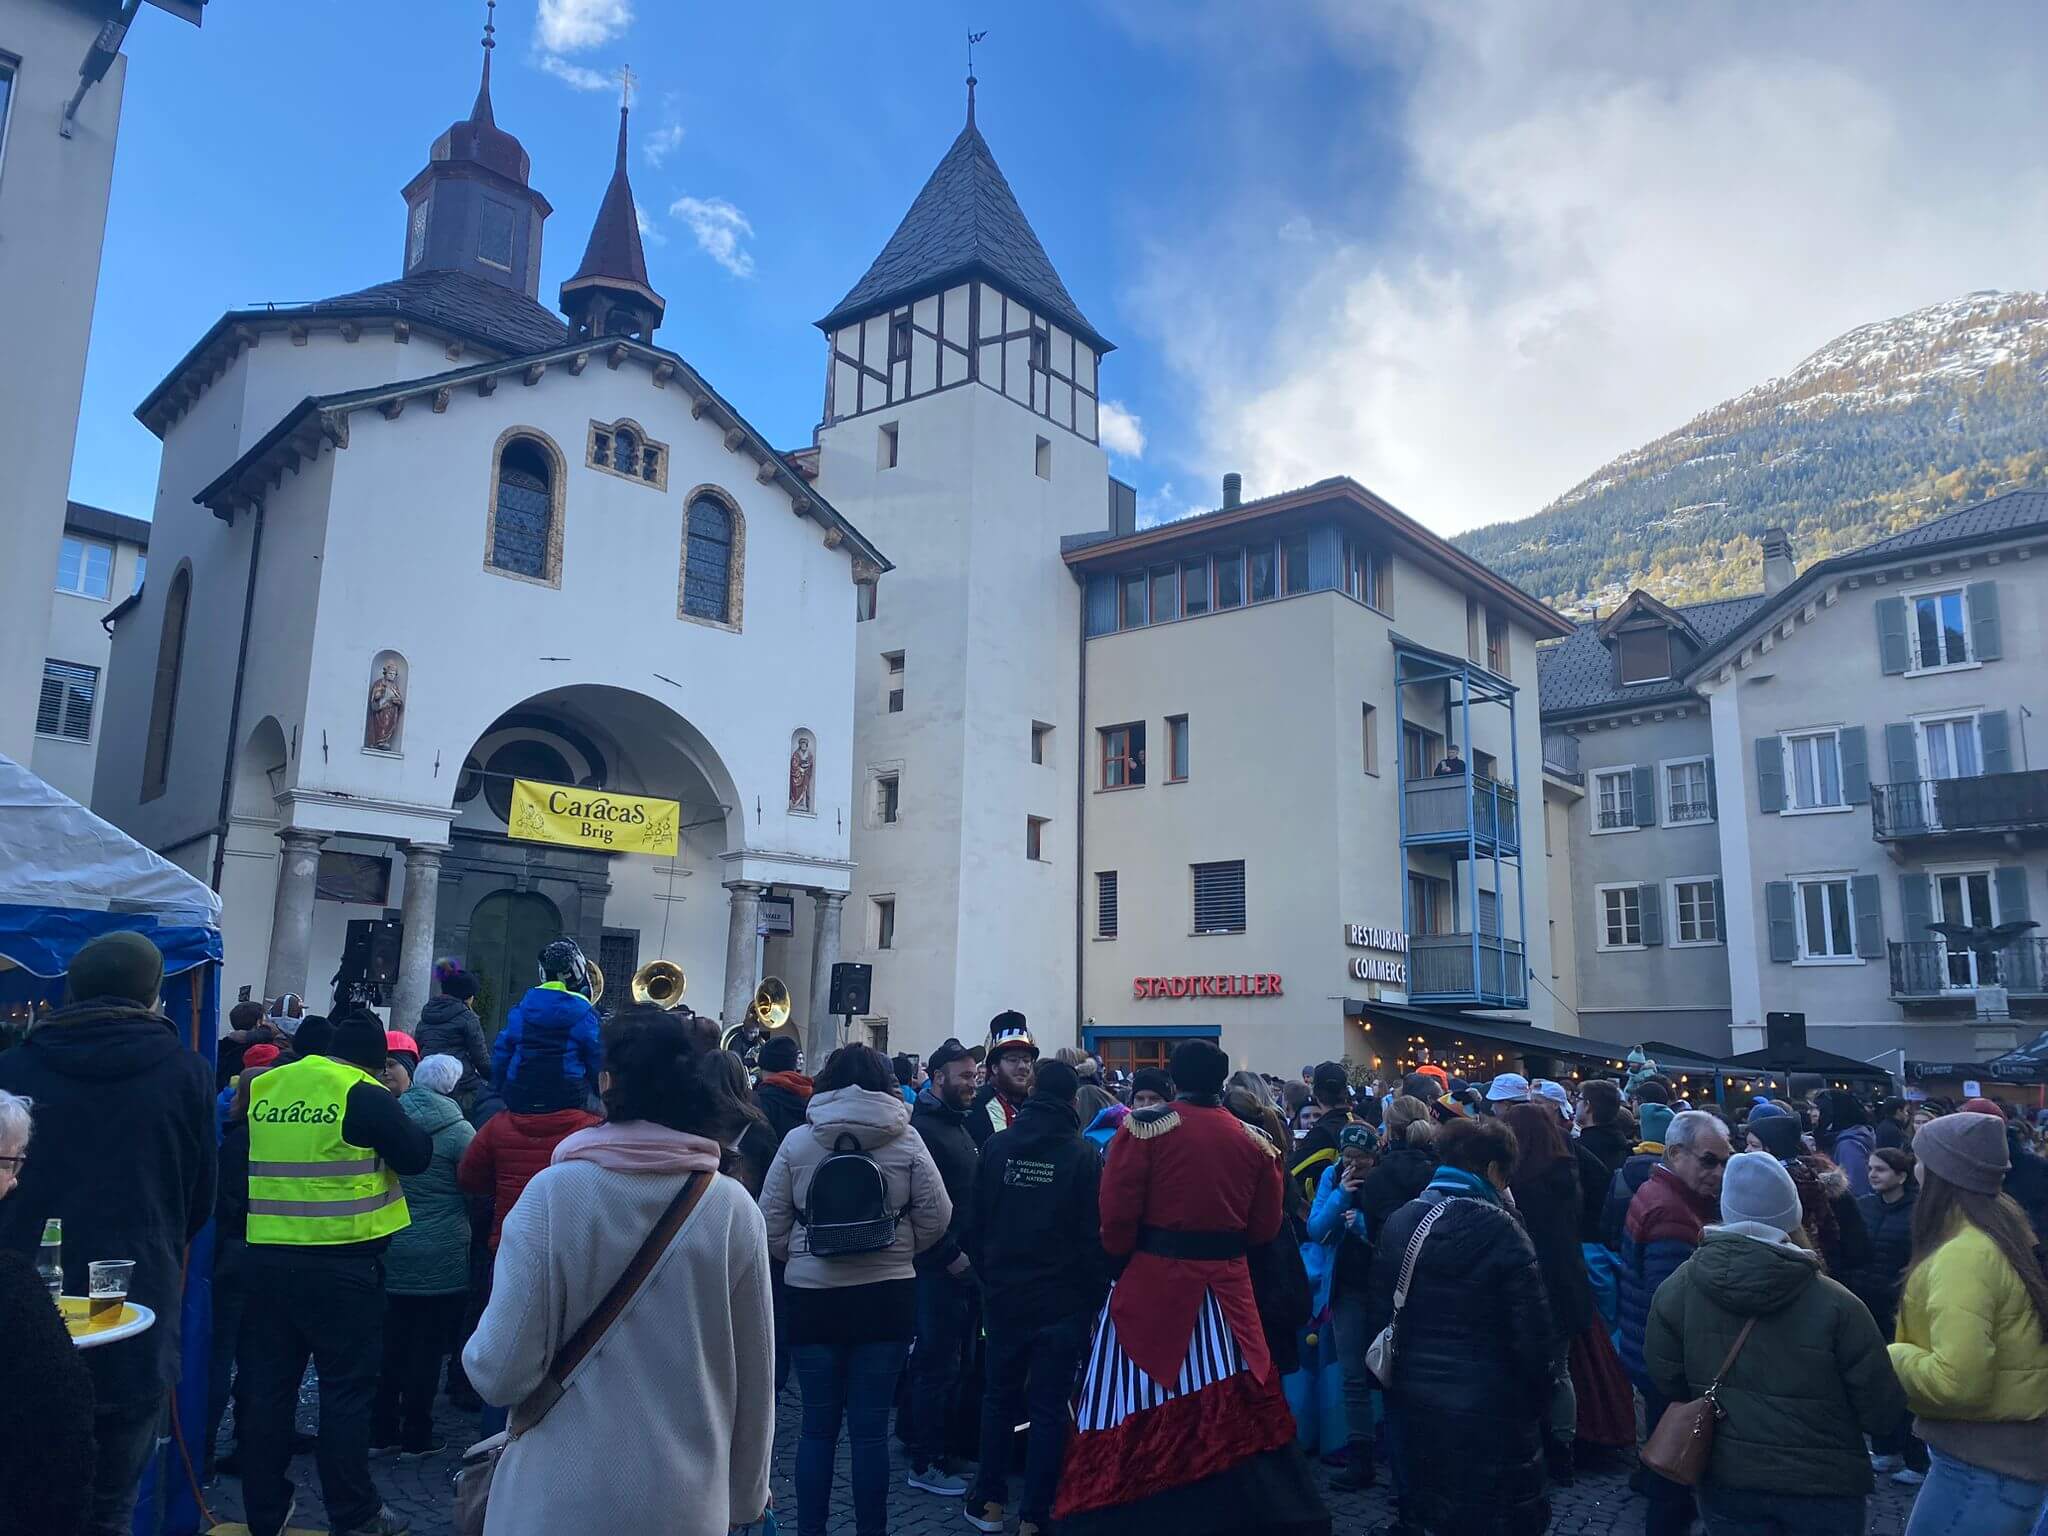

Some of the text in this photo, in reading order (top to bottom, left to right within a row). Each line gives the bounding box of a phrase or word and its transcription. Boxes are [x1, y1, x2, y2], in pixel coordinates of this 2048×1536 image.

[581, 823, 614, 844] Brig
[1351, 924, 1409, 953] RESTAURANT
[1355, 958, 1407, 983] COMMERCE
[1134, 973, 1283, 998] STADTKELLER
